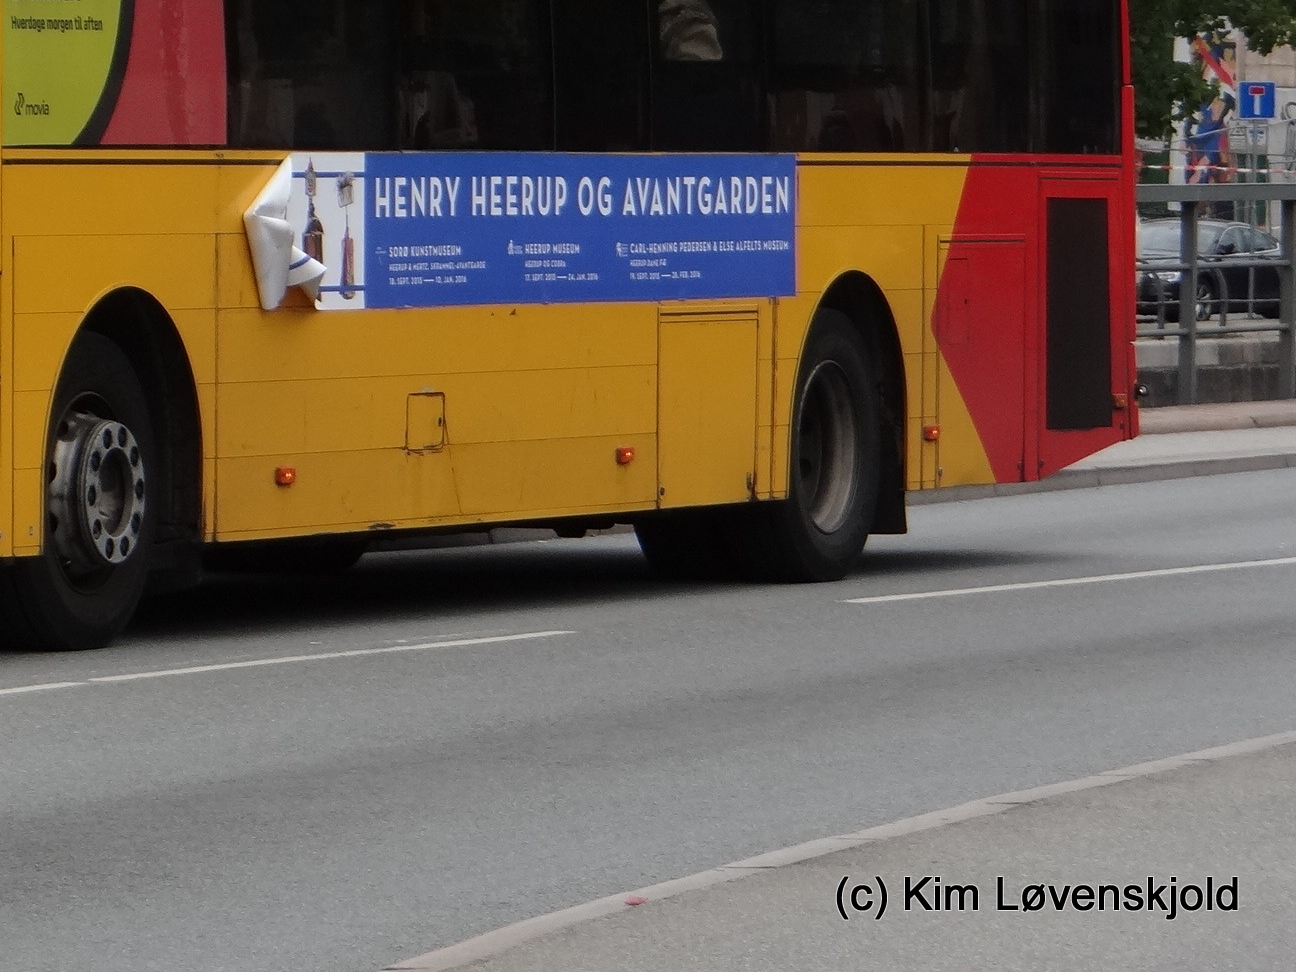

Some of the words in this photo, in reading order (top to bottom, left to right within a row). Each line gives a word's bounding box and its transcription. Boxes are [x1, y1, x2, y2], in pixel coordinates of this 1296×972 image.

[11, 15, 46, 32] Hverdage
[47, 17, 74, 33] morgen
[74, 15, 83, 31] til
[84, 16, 103, 31] aften
[25, 100, 50, 115] movia
[375, 177, 460, 218] HENRY
[471, 176, 567, 217] HEERUP
[577, 176, 612, 216] OG
[622, 175, 790, 216] AVANTGARDEN
[389, 246, 408, 257] SORØ
[410, 245, 461, 257] KUNSTMUSEUM
[525, 244, 550, 254] HEERUP
[552, 243, 580, 254] MUSEUM
[630, 242, 678, 253] CARL-HENNING
[679, 241, 711, 252] PEDERSEN
[719, 241, 734, 251] ELSE
[735, 240, 762, 252] ALFELTS
[763, 240, 789, 251] MUSEUM
